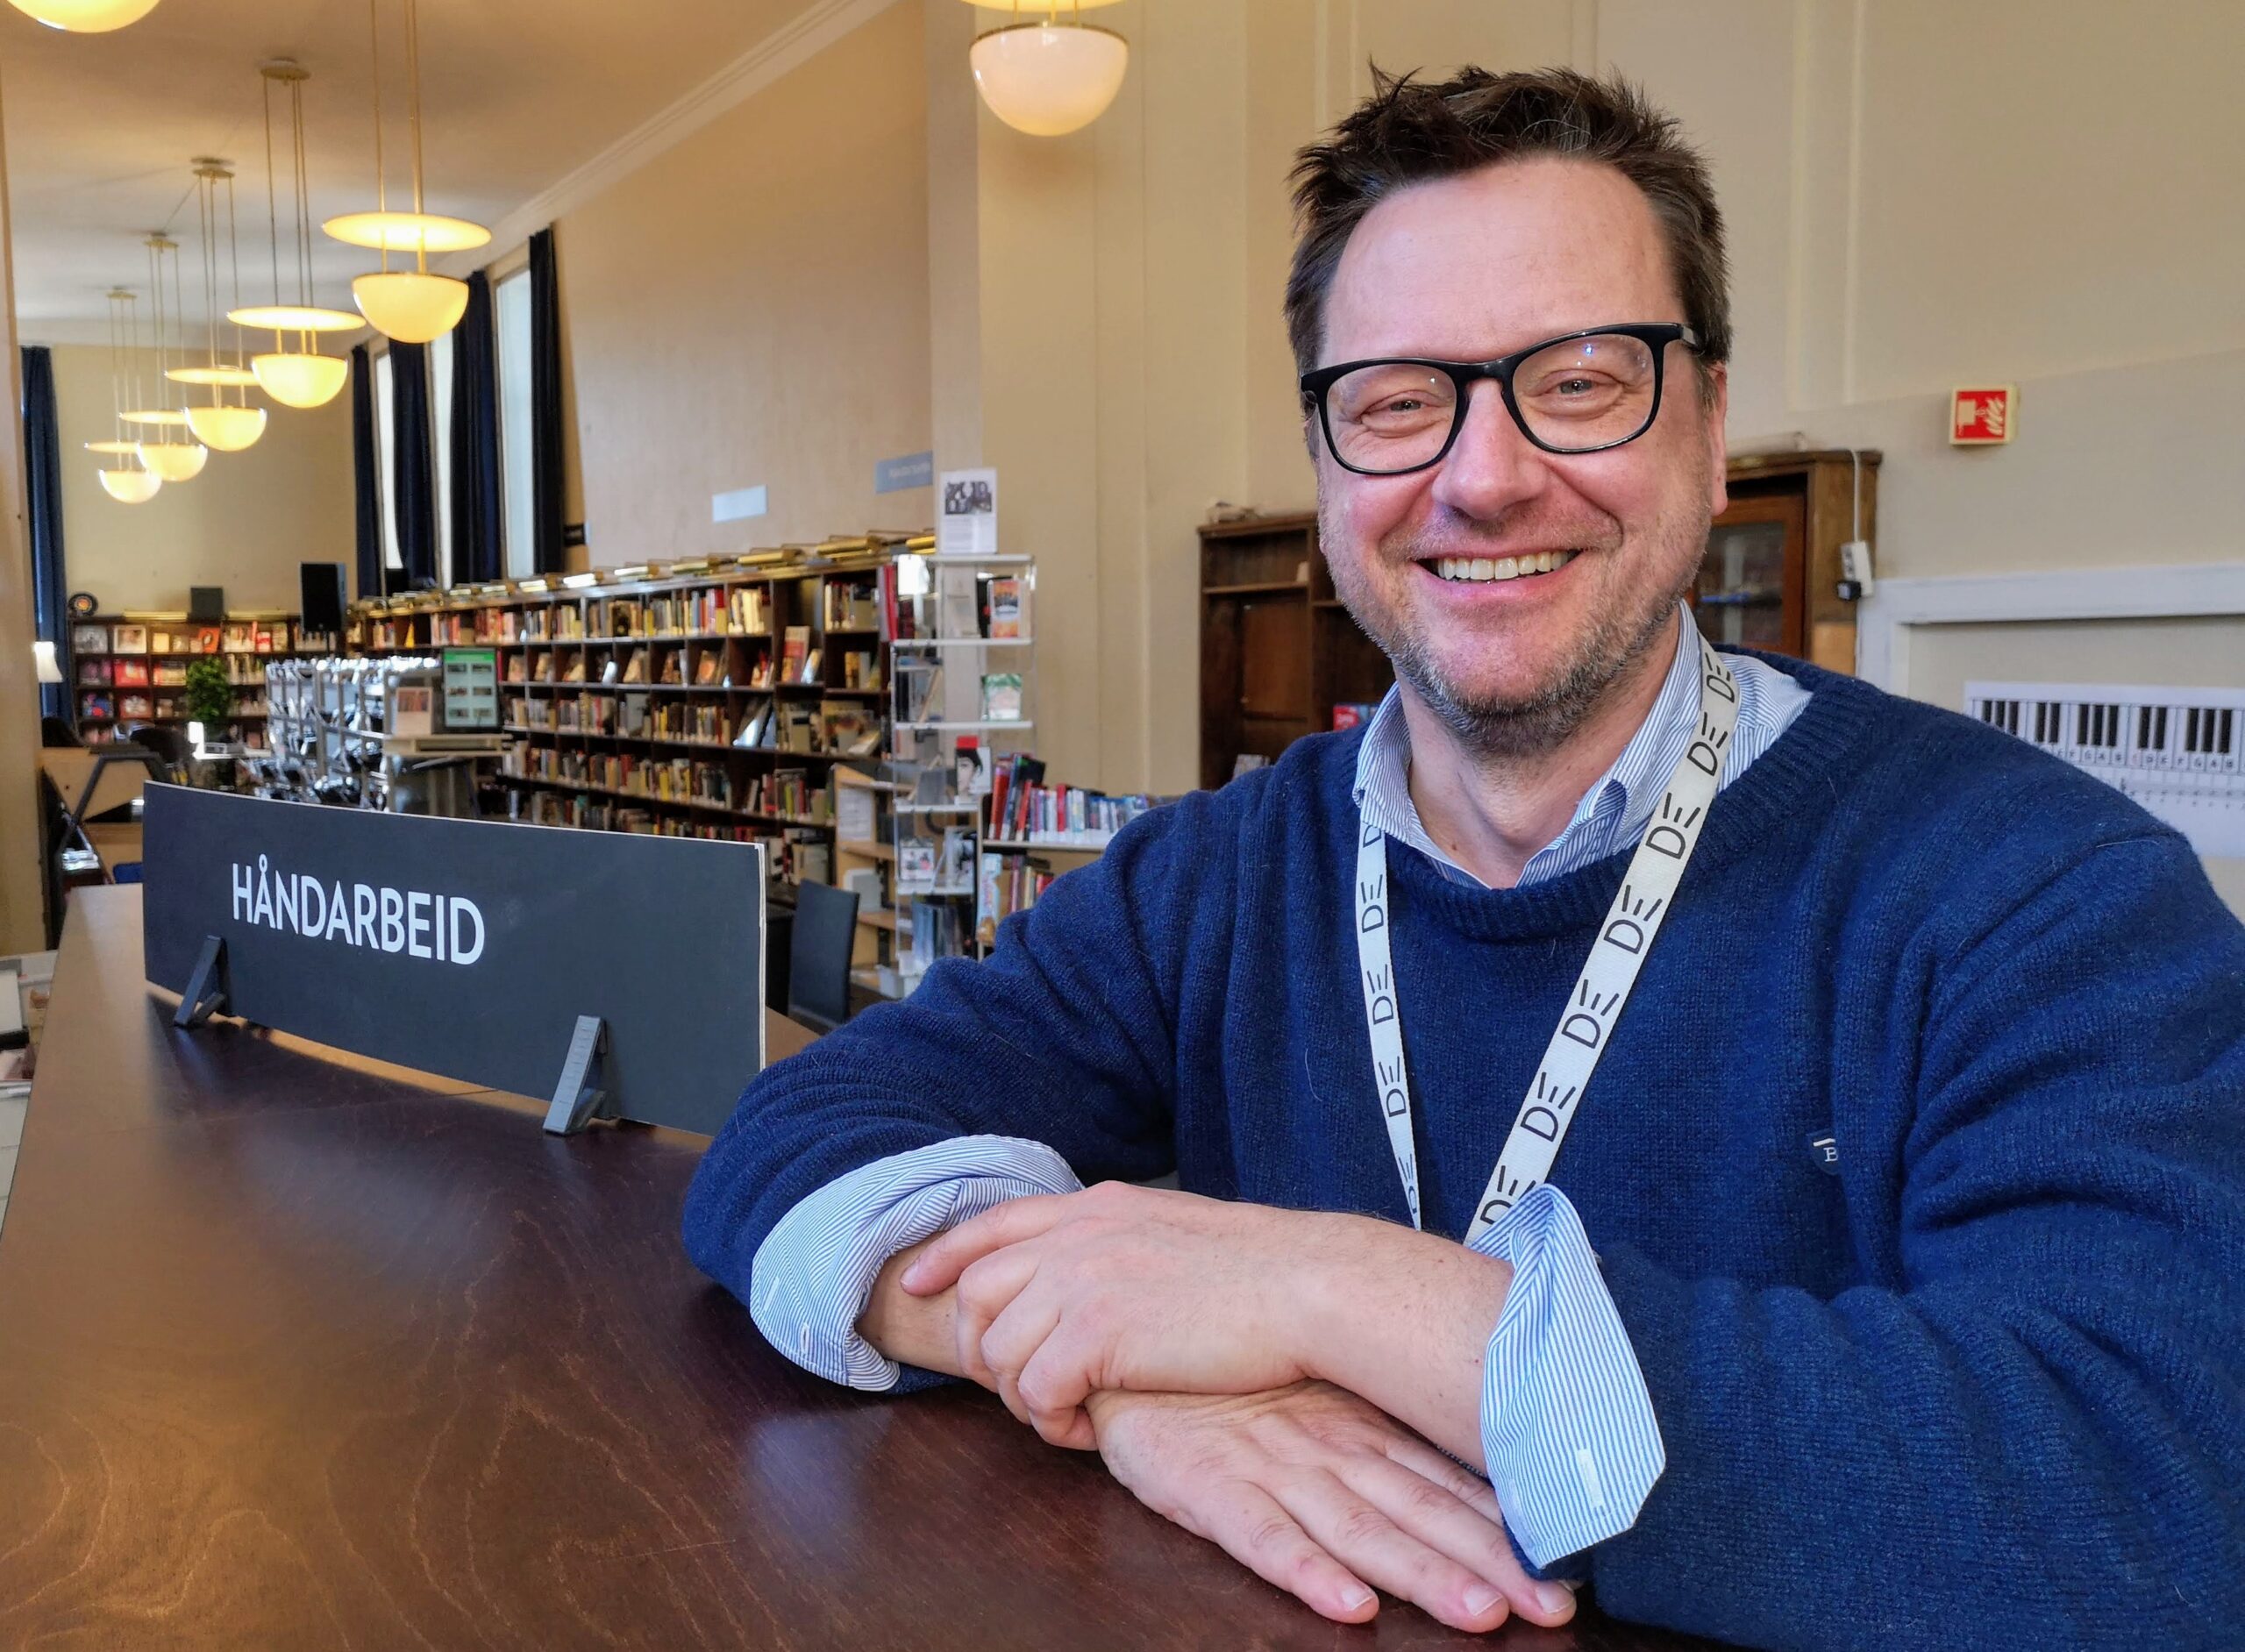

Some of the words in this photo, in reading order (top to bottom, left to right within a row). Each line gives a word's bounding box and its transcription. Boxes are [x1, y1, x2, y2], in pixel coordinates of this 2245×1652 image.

[1686, 711, 1728, 777] DE
[1645, 792, 1701, 860] DE
[232, 853, 485, 965] HÅNDARBEID
[1360, 873, 1385, 934] DE
[1603, 884, 1663, 954] DE
[1366, 963, 1394, 1026] DE
[1561, 979, 1619, 1050] DE
[1378, 1055, 1407, 1118] DE
[1520, 1072, 1576, 1142] DE
